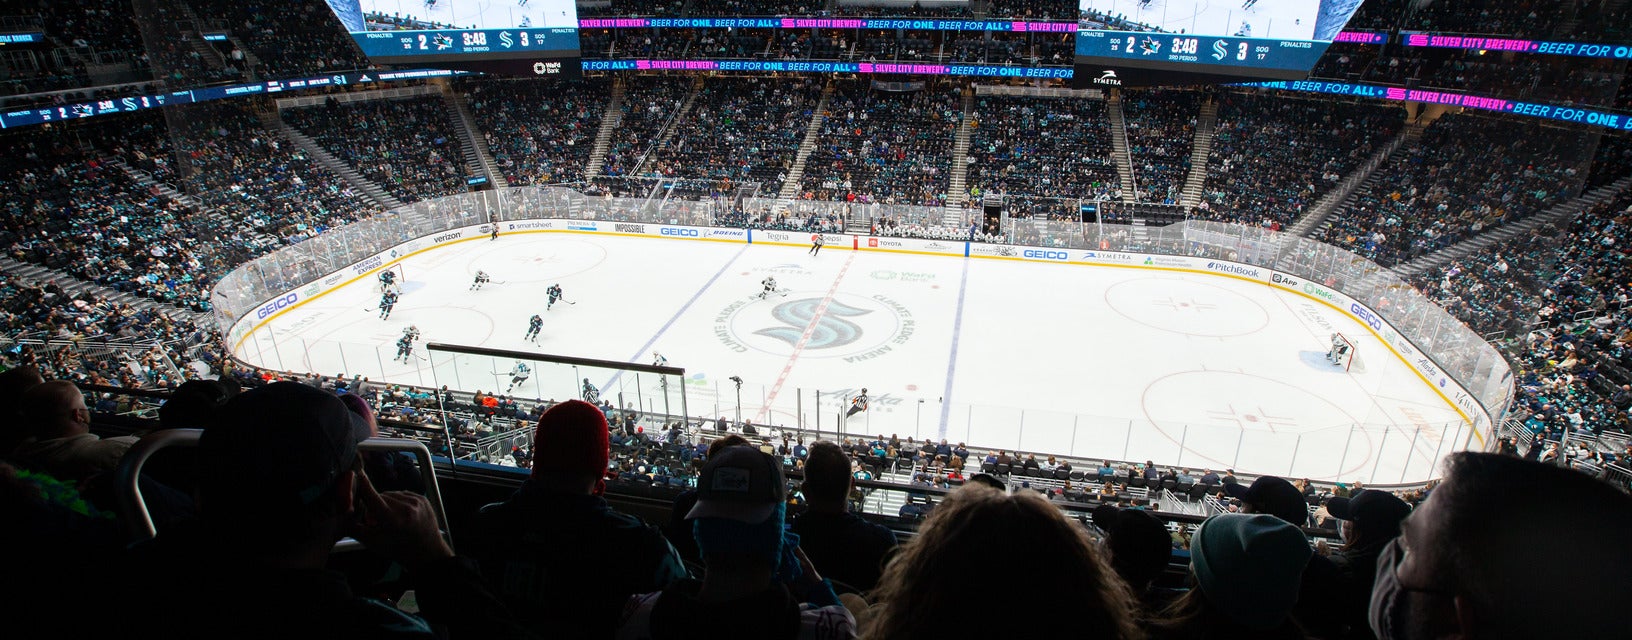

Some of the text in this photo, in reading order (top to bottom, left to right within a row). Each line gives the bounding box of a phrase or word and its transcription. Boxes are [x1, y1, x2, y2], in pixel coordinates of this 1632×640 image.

[580, 19, 599, 27] SILVER
[601, 19, 614, 27] CITY
[616, 19, 644, 27] BREWERY
[651, 19, 671, 27] BEER
[673, 19, 690, 27] FOR
[715, 19, 736, 27] BEER
[738, 19, 754, 27] FOR
[757, 19, 773, 27] ALL
[832, 20, 861, 28] BREWERY
[868, 20, 889, 29] BEER
[892, 20, 910, 29] FOR
[939, 22, 962, 30] BEER
[964, 22, 983, 30] FOR
[986, 22, 1003, 30] ALL
[1029, 22, 1050, 31] SILVER
[1052, 22, 1066, 31] CITY
[419, 35, 428, 50] 2
[463, 33, 487, 46] 3:48
[520, 32, 529, 46] 3
[1125, 37, 1135, 53] 2
[1172, 38, 1197, 54] 3:48
[1431, 36, 1460, 47] SILVER
[1462, 38, 1483, 48] CITY
[1485, 39, 1531, 51] BREWERY
[1539, 42, 1575, 54] BEER
[1578, 44, 1610, 56] FOR
[1237, 43, 1247, 60] 3
[672, 61, 685, 69] CITY
[742, 62, 761, 70] FOR
[788, 62, 810, 70] BEER
[813, 63, 830, 71] FOR
[834, 63, 850, 71] ALL
[876, 64, 896, 72] SILVER
[898, 64, 912, 72] CITY
[914, 65, 944, 73] BREWERY
[951, 66, 974, 75] BEER
[978, 67, 997, 75] FOR
[1026, 68, 1050, 77] BEER
[1054, 69, 1073, 78] FOR
[58, 107, 68, 118] 2
[1292, 81, 1321, 91] BEER
[1325, 84, 1350, 94] FOR
[1352, 86, 1374, 96] ALL
[1409, 90, 1438, 102] SILVER
[1440, 93, 1461, 104] CITY
[1462, 95, 1506, 110] BREWERY
[1514, 103, 1550, 117] BEER
[1553, 107, 1587, 121] FOR
[1587, 111, 1620, 128] ONE,
[615, 224, 645, 233] IMPOSSIBLE
[661, 228, 698, 236] GEICO
[434, 231, 461, 243] verizon
[767, 233, 789, 241] Tegria
[352, 255, 381, 271] AMERICAN
[1024, 250, 1068, 260] GEICO
[358, 261, 382, 275] EXPRESS
[1215, 264, 1259, 278] PitchBook
[1316, 288, 1332, 299] WaFd
[257, 293, 298, 320] GEICO
[715, 300, 746, 323] PLEDGE
[872, 294, 912, 317] CLIMATE
[1350, 303, 1382, 331] GEICO
[714, 326, 748, 352] CLIMATE
[892, 320, 915, 344] PLEDGE
[843, 345, 892, 364] ARENA
[1418, 359, 1436, 376] Alaska
